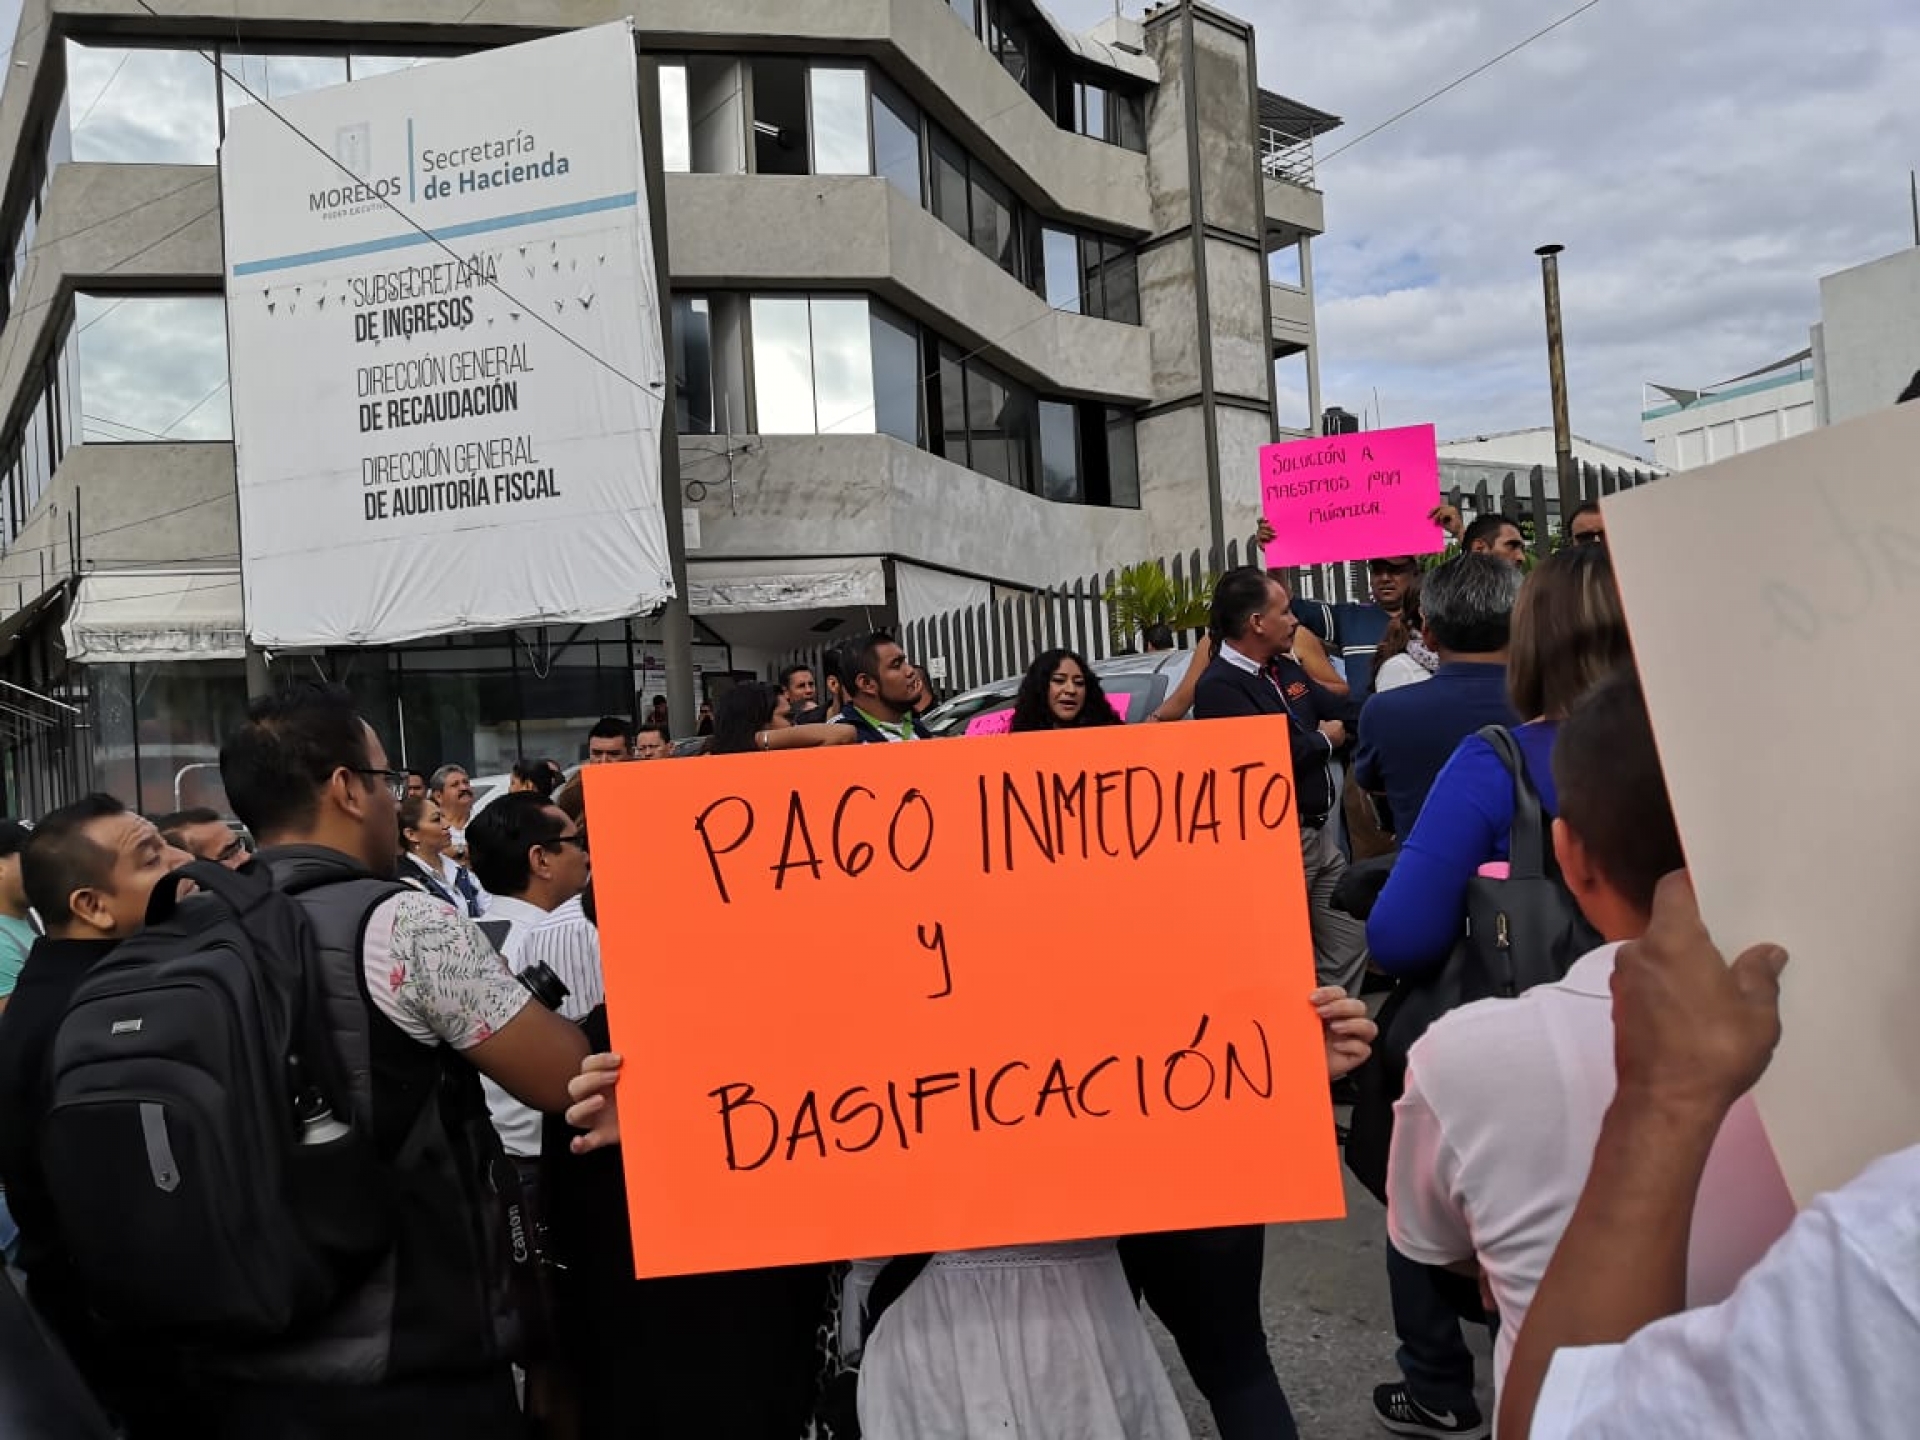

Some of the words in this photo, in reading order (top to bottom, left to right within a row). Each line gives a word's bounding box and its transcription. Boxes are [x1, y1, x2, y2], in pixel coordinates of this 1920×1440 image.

[422, 130, 535, 173] Secretaría
[424, 175, 450, 200] de
[459, 151, 570, 195] Hacienda
[309, 176, 401, 212] MORELOS
[353, 250, 499, 307] SUBSECRETARÍA
[355, 311, 379, 343] DE
[382, 295, 474, 339] INGRESOS
[357, 352, 446, 397] DIRECCIÓN
[450, 342, 534, 383] GENERAL
[360, 402, 383, 433] DE
[387, 377, 518, 429] RECAUDACIÓN
[362, 442, 451, 486] DIRECCIÓN
[454, 434, 540, 474] GENERAL
[1272, 443, 1346, 476] SOLUCIÓN
[1362, 446, 1374, 462] A
[364, 490, 388, 520] DE
[392, 472, 491, 517] AUDITORÍA
[494, 467, 561, 504] FISCAL
[694, 785, 935, 905] PAGO
[979, 762, 1291, 874] INMEDIATO
[709, 1015, 1273, 1171] BASIFICACIÓN
[508, 1204, 528, 1262] Canon
